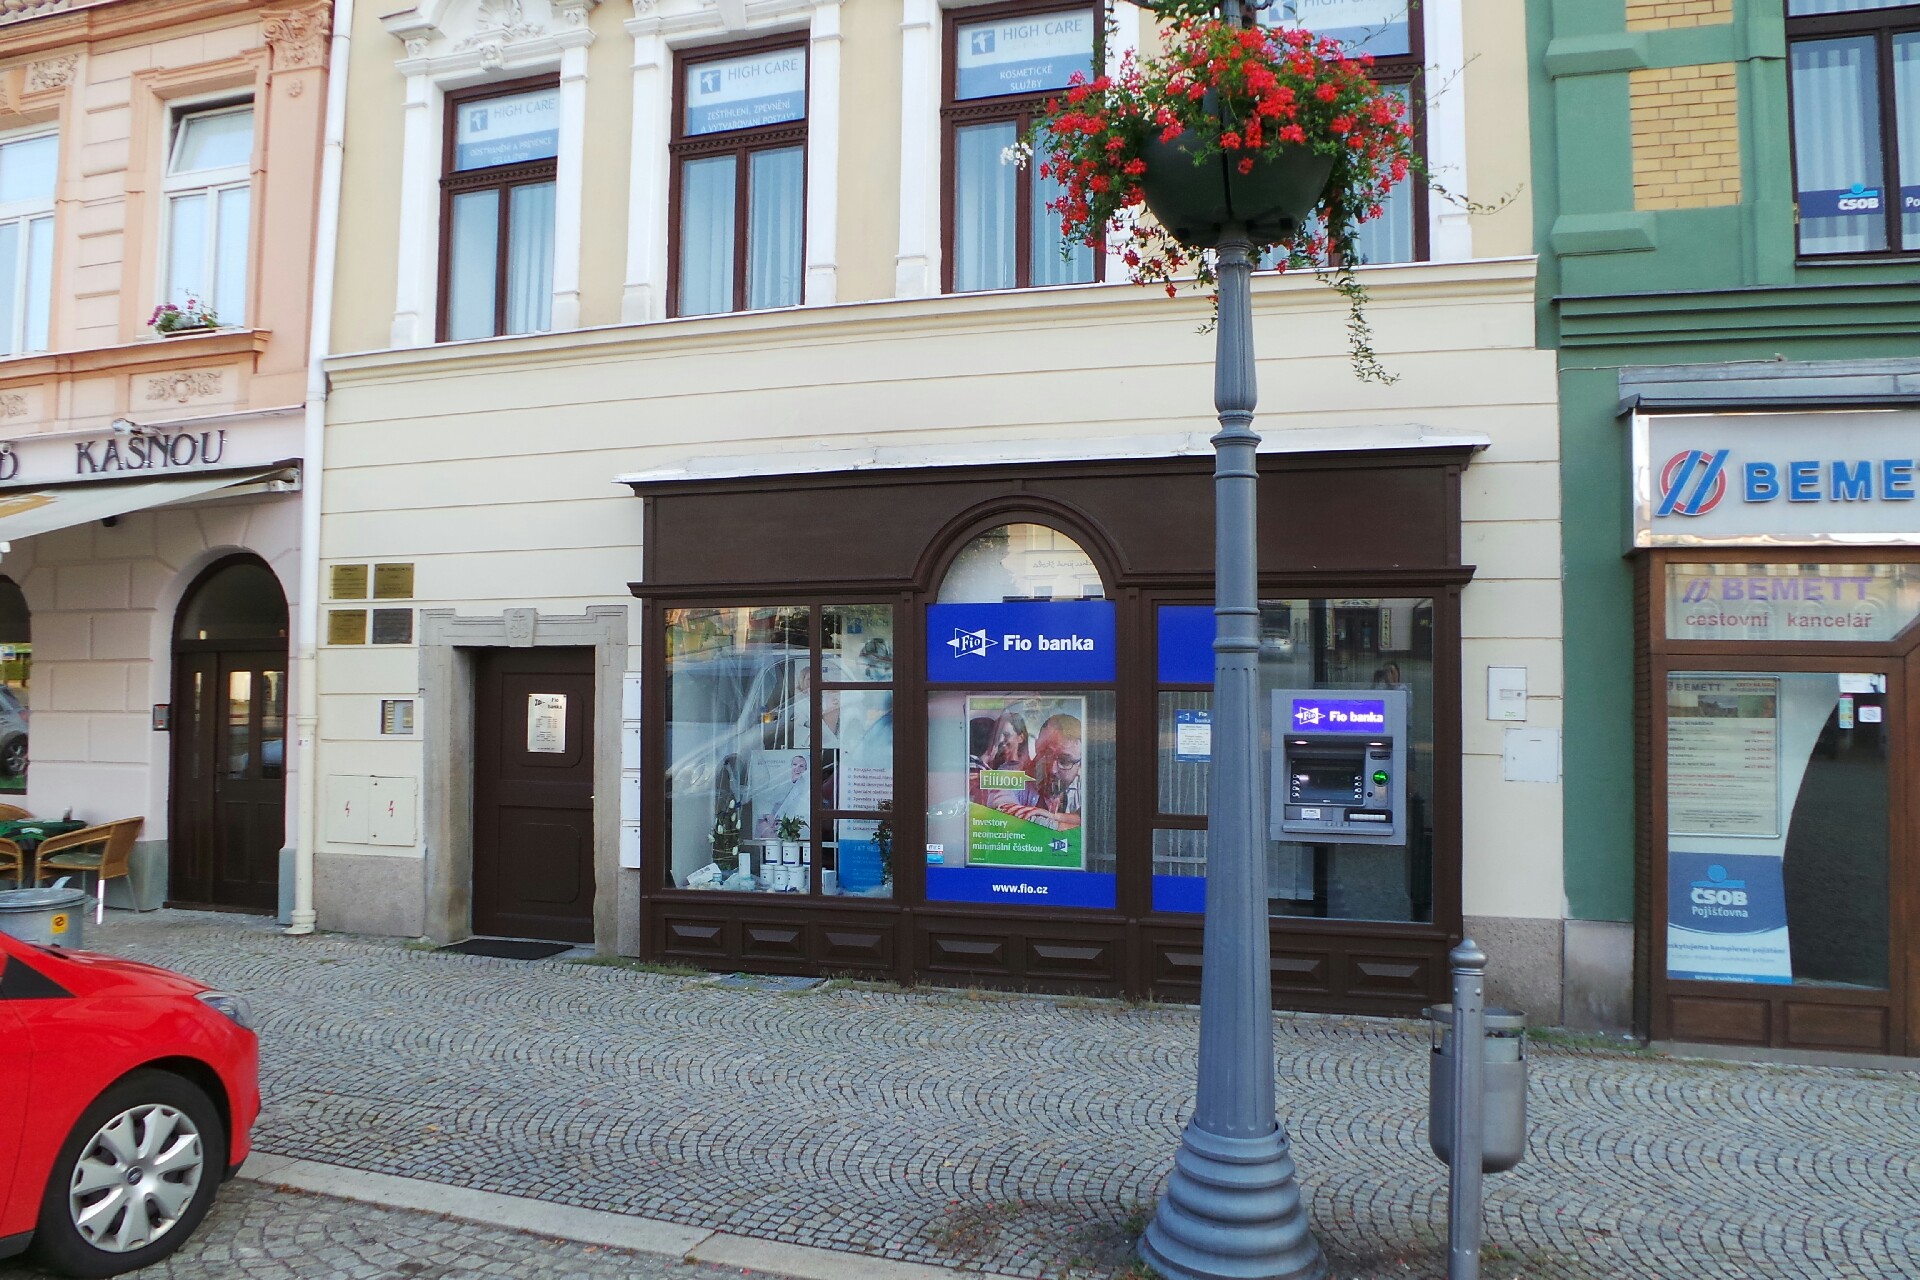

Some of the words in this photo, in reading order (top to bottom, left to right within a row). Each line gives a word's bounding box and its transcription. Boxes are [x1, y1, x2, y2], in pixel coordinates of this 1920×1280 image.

[1003, 24, 1038, 40] HIGH
[1045, 19, 1082, 36] CARE
[728, 64, 759, 80] HIGH
[765, 58, 798, 75] CARE
[1000, 64, 1053, 80] KOSMETICKÉ
[1010, 79, 1042, 91] SLUŽBY
[494, 103, 522, 118] HIGH
[526, 98, 555, 114] CARE
[1743, 459, 1920, 502] BEME
[1721, 577, 1873, 601] BEMETT
[1685, 612, 1769, 628] cestovní
[1787, 612, 1872, 628] kancelář
[961, 635, 981, 651] Fio
[1003, 634, 1032, 651] Fio
[1038, 634, 1094, 651] banka
[1329, 711, 1347, 722] Fio
[1350, 711, 1384, 723] banka
[972, 817, 1008, 829] Investory
[972, 830, 1026, 841] neomezujeme
[972, 842, 1011, 851] minimální
[1012, 842, 1043, 853] částkou
[992, 883, 1049, 895] www.fio.cz
[1690, 887, 1748, 906] ČSOB
[1692, 905, 1749, 919] Pojišťovna
